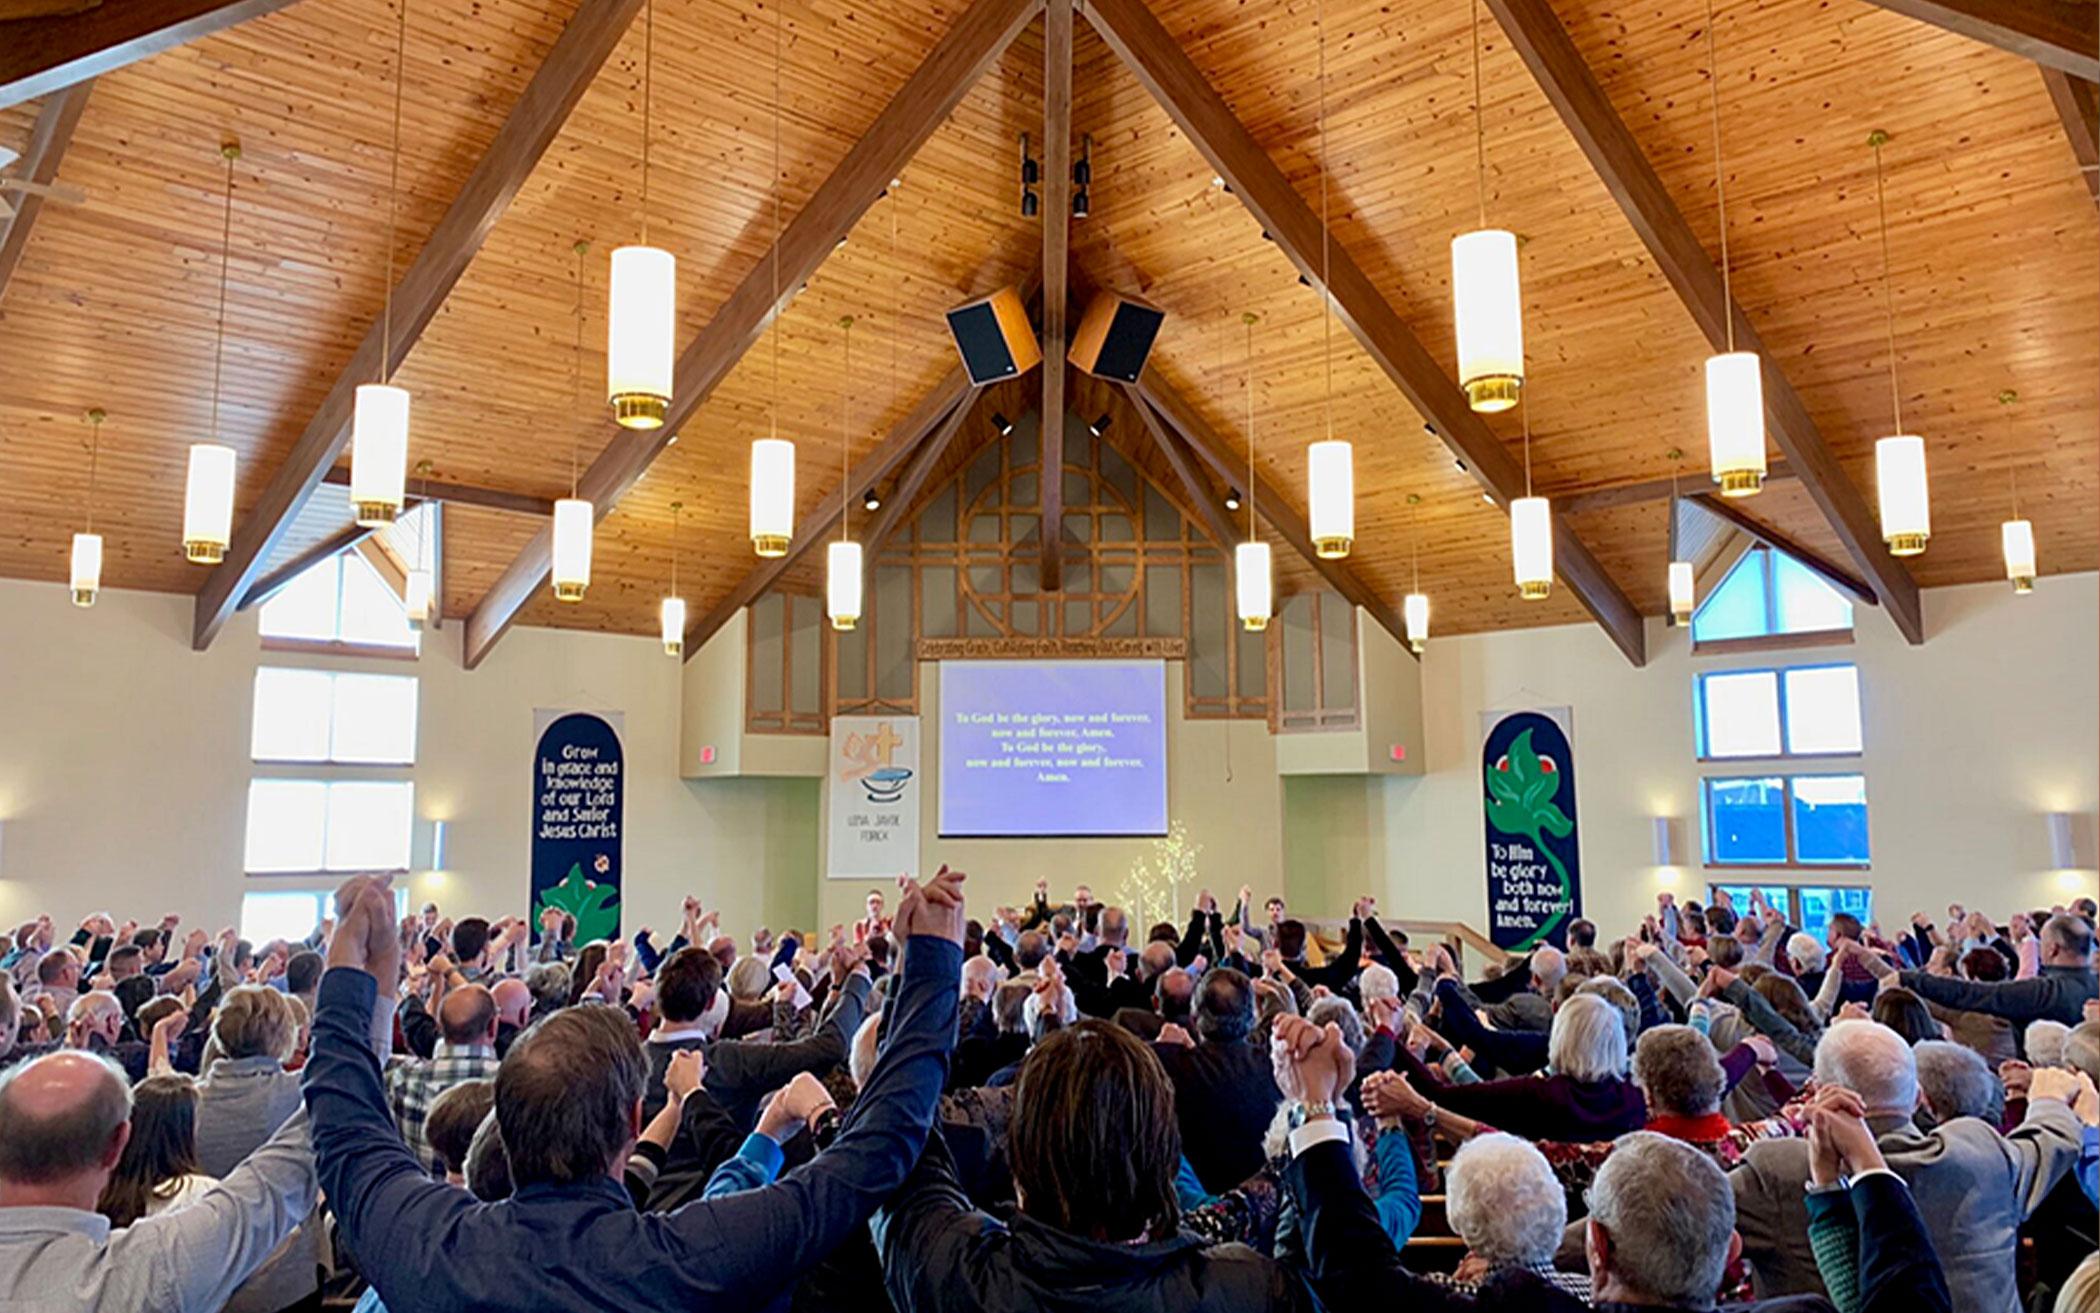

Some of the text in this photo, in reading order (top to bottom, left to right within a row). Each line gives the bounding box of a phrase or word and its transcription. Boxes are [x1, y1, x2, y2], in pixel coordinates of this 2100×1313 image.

[956, 713, 1151, 726] To God be the glory, now and forever,
[991, 730, 1012, 738] now
[1016, 728, 1035, 738] and
[1082, 728, 1115, 738] Amen.
[562, 744, 598, 760] Grow
[1002, 743, 1014, 752] To
[1016, 743, 1039, 752] God
[1042, 743, 1054, 752] be
[1057, 743, 1073, 752] the
[557, 762, 592, 778] grace
[594, 761, 618, 775] and
[966, 760, 987, 768] now
[991, 758, 1010, 768] and
[1056, 760, 1077, 768] now
[1081, 758, 1100, 768] and
[546, 776, 615, 791] knowledge
[1036, 772, 1071, 782] Amen.
[541, 791, 615, 806] of our Lord
[542, 808, 569, 822] and
[539, 823, 617, 838] Jesus Christ
[1491, 844, 1534, 861] To Him
[1491, 863, 1547, 880] be glory
[1503, 880, 1564, 896] both now
[1495, 897, 1574, 914] and forever!
[1497, 913, 1537, 928] Amen.
